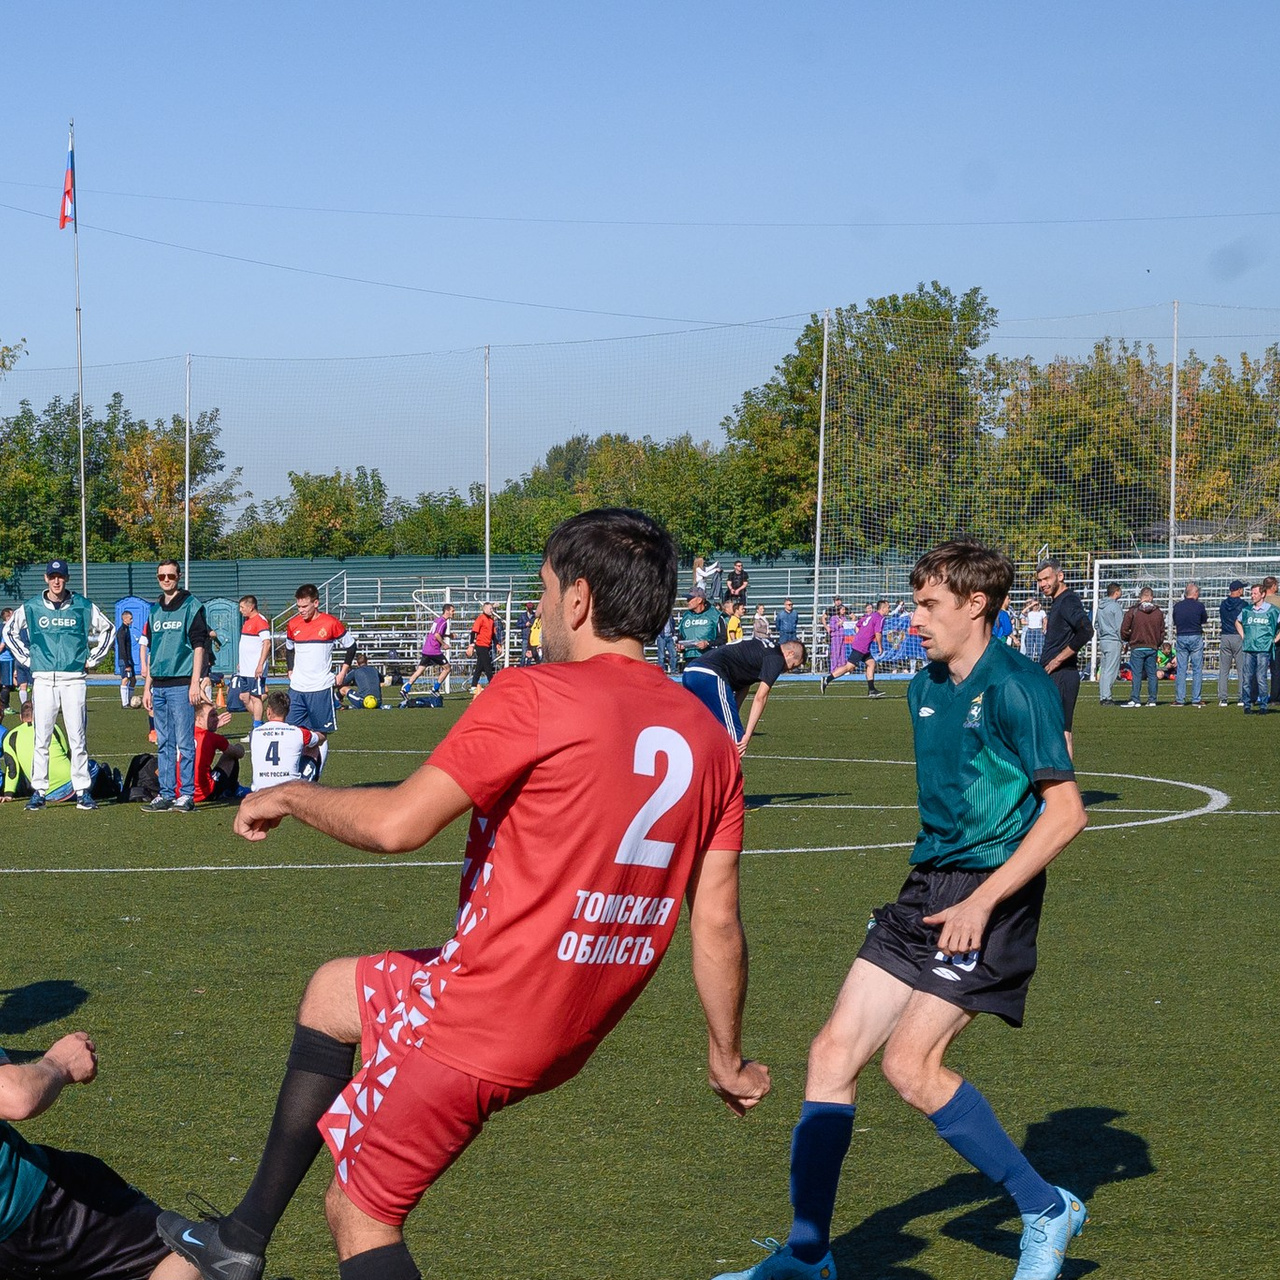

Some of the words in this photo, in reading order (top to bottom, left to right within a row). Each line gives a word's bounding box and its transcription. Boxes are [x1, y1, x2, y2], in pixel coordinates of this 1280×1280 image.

[51, 618, 77, 626] СБЕР
[162, 621, 182, 629] СБЕР
[265, 740, 281, 766] 4
[614, 725, 694, 869] 2
[572, 889, 676, 926] ТОМСКАЯ
[557, 931, 656, 965] ОБЛАСТЬ
